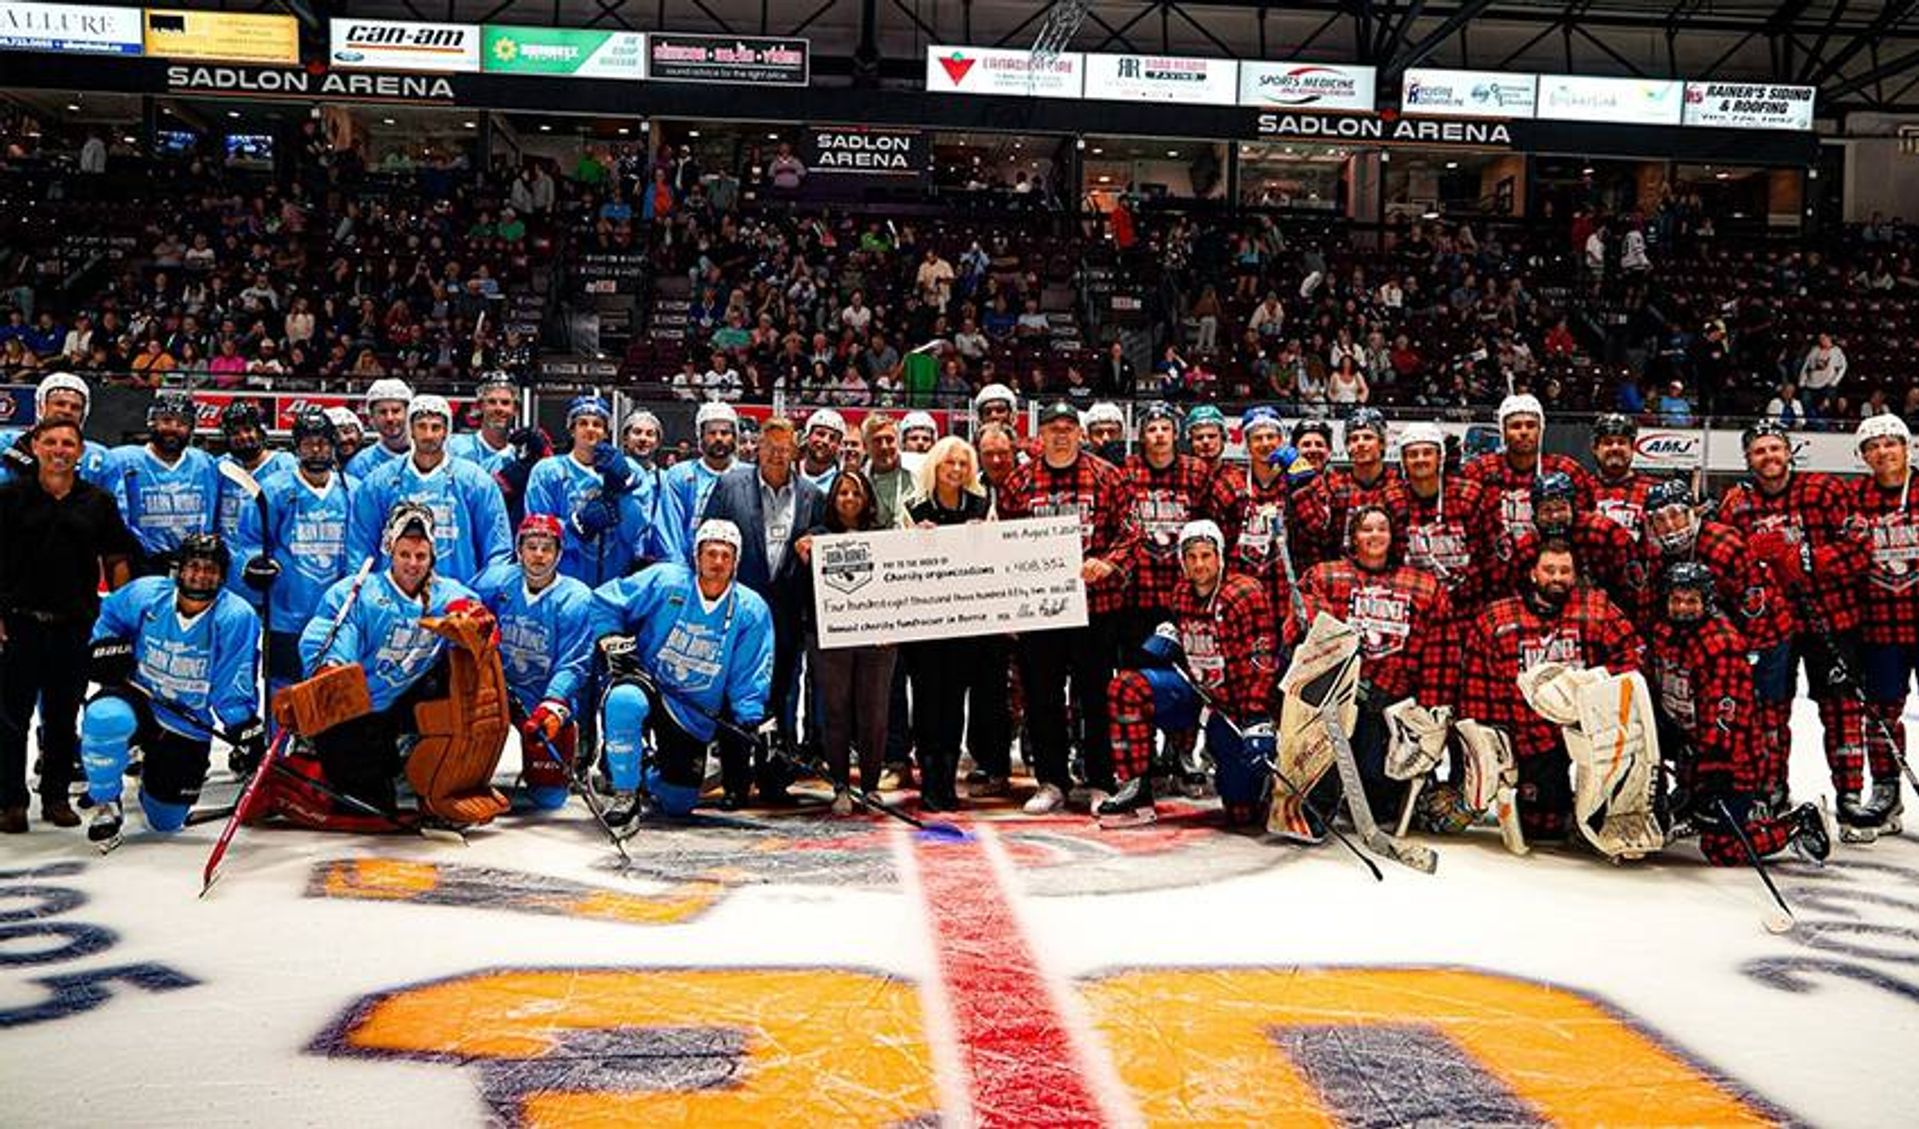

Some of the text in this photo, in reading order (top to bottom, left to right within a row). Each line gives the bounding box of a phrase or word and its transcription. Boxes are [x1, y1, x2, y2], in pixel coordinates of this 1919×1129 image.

[167, 66, 454, 98] SADLON ARENA
[1259, 75, 1356, 89] SPORTS MEDICINE
[1258, 114, 1512, 143] SADLON ARENA
[817, 134, 910, 151] SADLON
[819, 151, 908, 168] ARENA
[1646, 440, 1692, 453] AMJ
